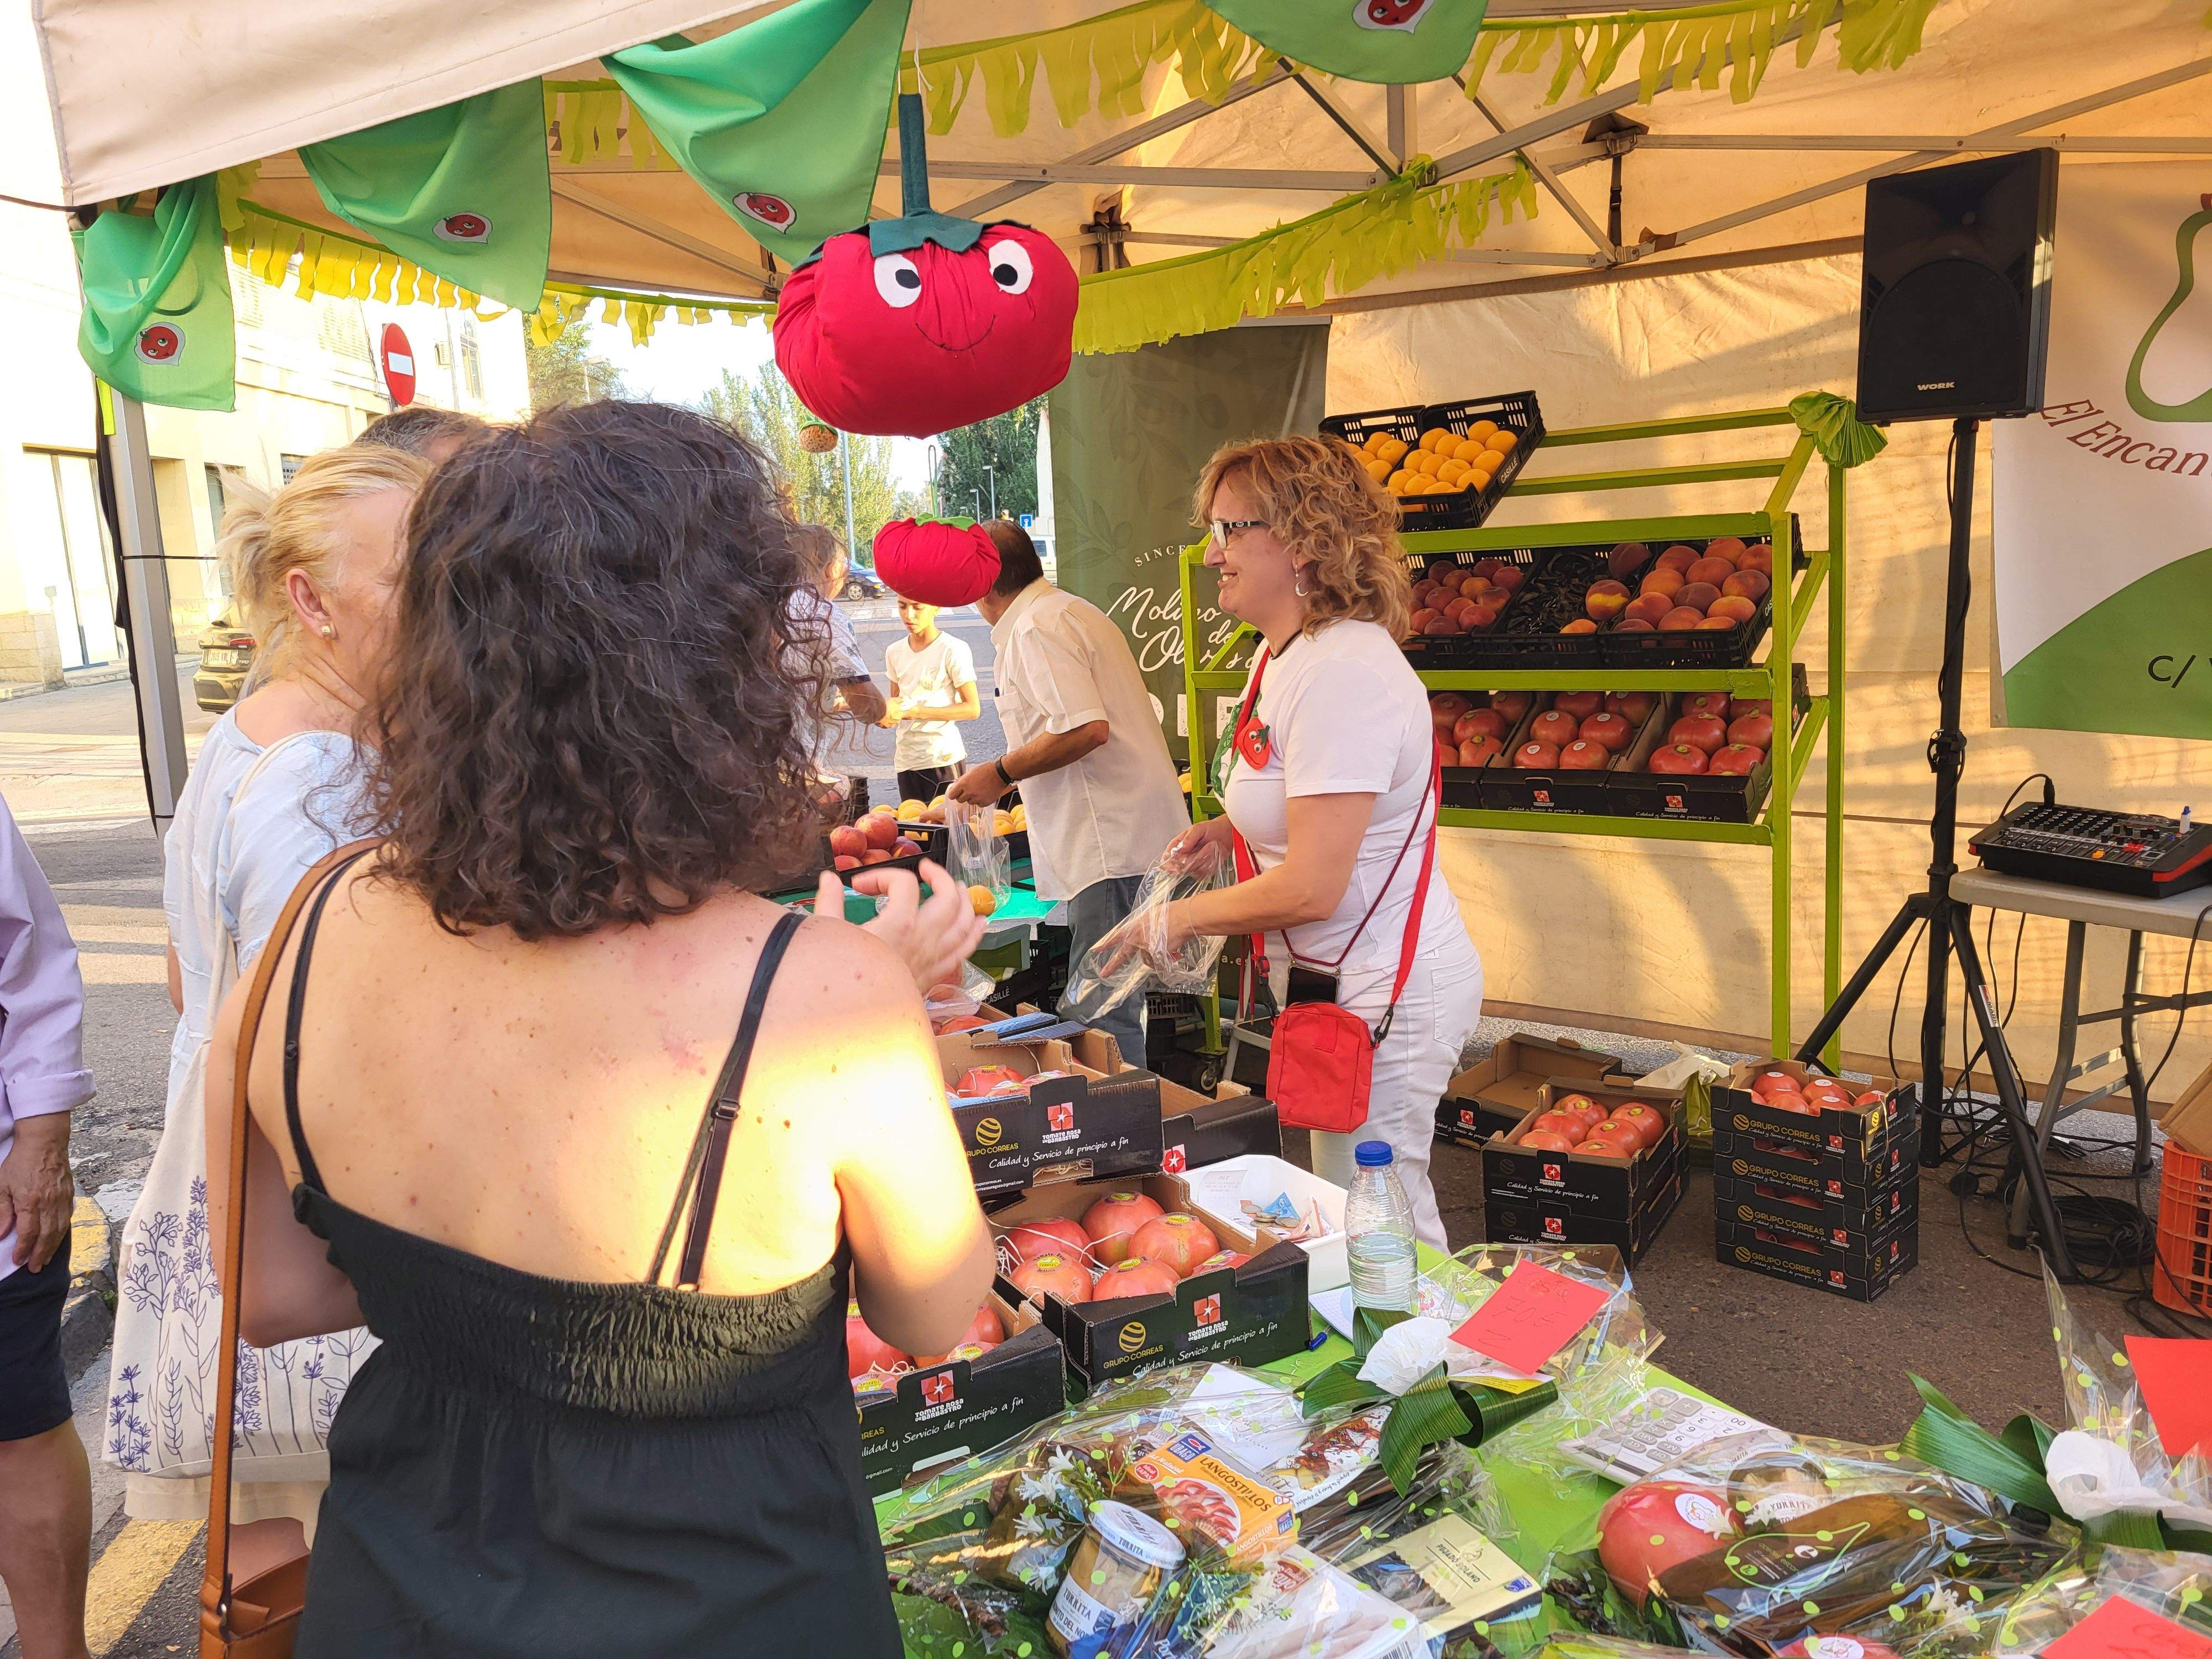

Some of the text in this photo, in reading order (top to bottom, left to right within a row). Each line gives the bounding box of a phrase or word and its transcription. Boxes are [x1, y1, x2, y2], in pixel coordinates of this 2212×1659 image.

[1917, 382, 1955, 390] WORK
[2040, 399, 2212, 477] El Encan
[1105, 587, 1222, 639] Molio
[2148, 655, 2197, 688] C/
[1750, 1120, 1820, 1142] GRUPO CORREAS
[966, 1142, 1019, 1157] RUPO CORREAS
[989, 1155, 1021, 1168] Calidad
[1022, 1156, 1029, 1167] y
[1032, 1150, 1061, 1161] Servicio
[1065, 1146, 1074, 1155] de
[1077, 1141, 1107, 1156] principio
[1117, 1137, 1129, 1150] fin
[1749, 1165, 1819, 1187] GRUPO CORREAS
[1507, 1182, 1527, 1190] Calidad
[1533, 1185, 1553, 1194] Servicio
[1562, 1191, 1584, 1199] principio
[1590, 1193, 1599, 1202] fin
[1754, 1211, 1824, 1235] GRUPO CORREAS
[1752, 1253, 1822, 1276] GRUPO CORREAS
[1103, 1344, 1164, 1369] GRUPO CORREAS
[1133, 1357, 1166, 1376] Calidad
[1169, 1357, 1175, 1368] y
[1178, 1347, 1208, 1361] Servicio
[1211, 1340, 1220, 1349] de
[1223, 1331, 1256, 1349] principio
[1265, 1322, 1277, 1338] fin
[862, 1439, 888, 1457] lidad
[890, 1439, 899, 1452] y
[903, 1426, 940, 1443] Servicio
[944, 1420, 955, 1431] de
[959, 1407, 998, 1430] principio
[1010, 1396, 1024, 1413] fin
[1170, 1443, 1195, 1461] UBAGO
[1136, 1466, 1153, 1479] TAPAS
[1118, 1536, 1143, 1556] YURRITA
[1236, 1525, 1273, 1551] ANGOSTILLOS
[1063, 1587, 1091, 1620] YURRITA
[1063, 1616, 1074, 1632] DEL
